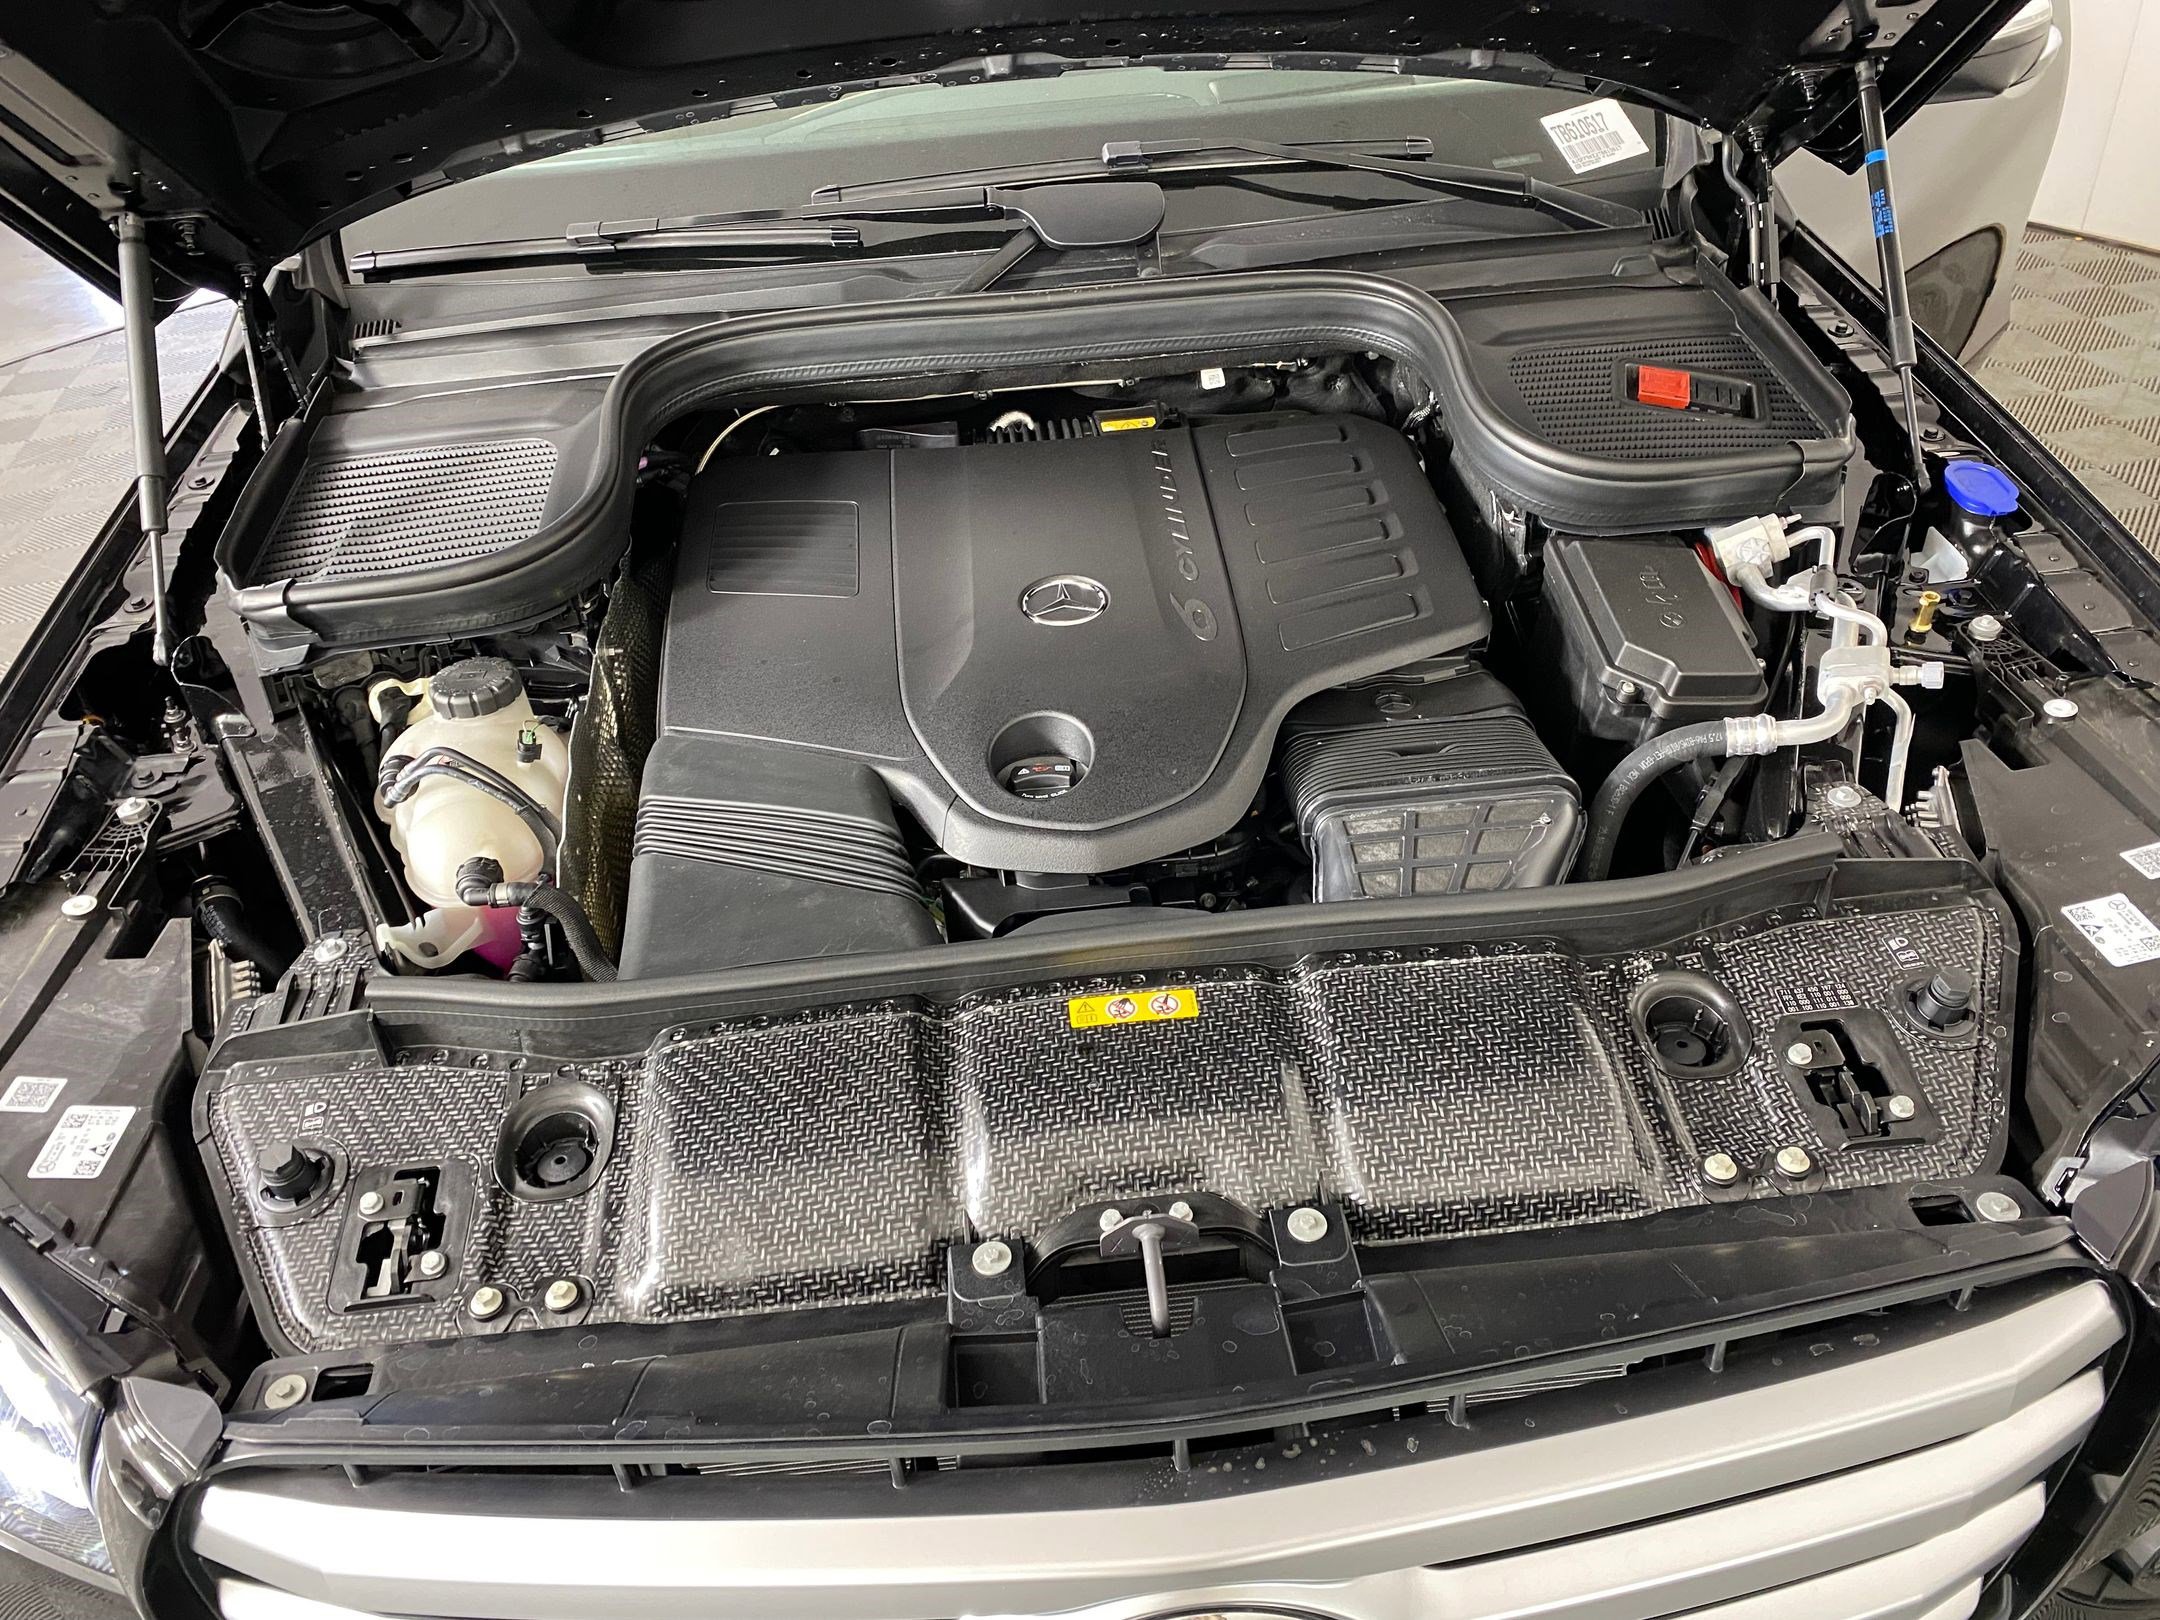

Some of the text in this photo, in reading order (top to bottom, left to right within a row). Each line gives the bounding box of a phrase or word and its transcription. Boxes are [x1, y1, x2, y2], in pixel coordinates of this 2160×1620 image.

[1550, 112, 1609, 144] TB610517
[1152, 439, 1218, 641] 6 CYLINDER
